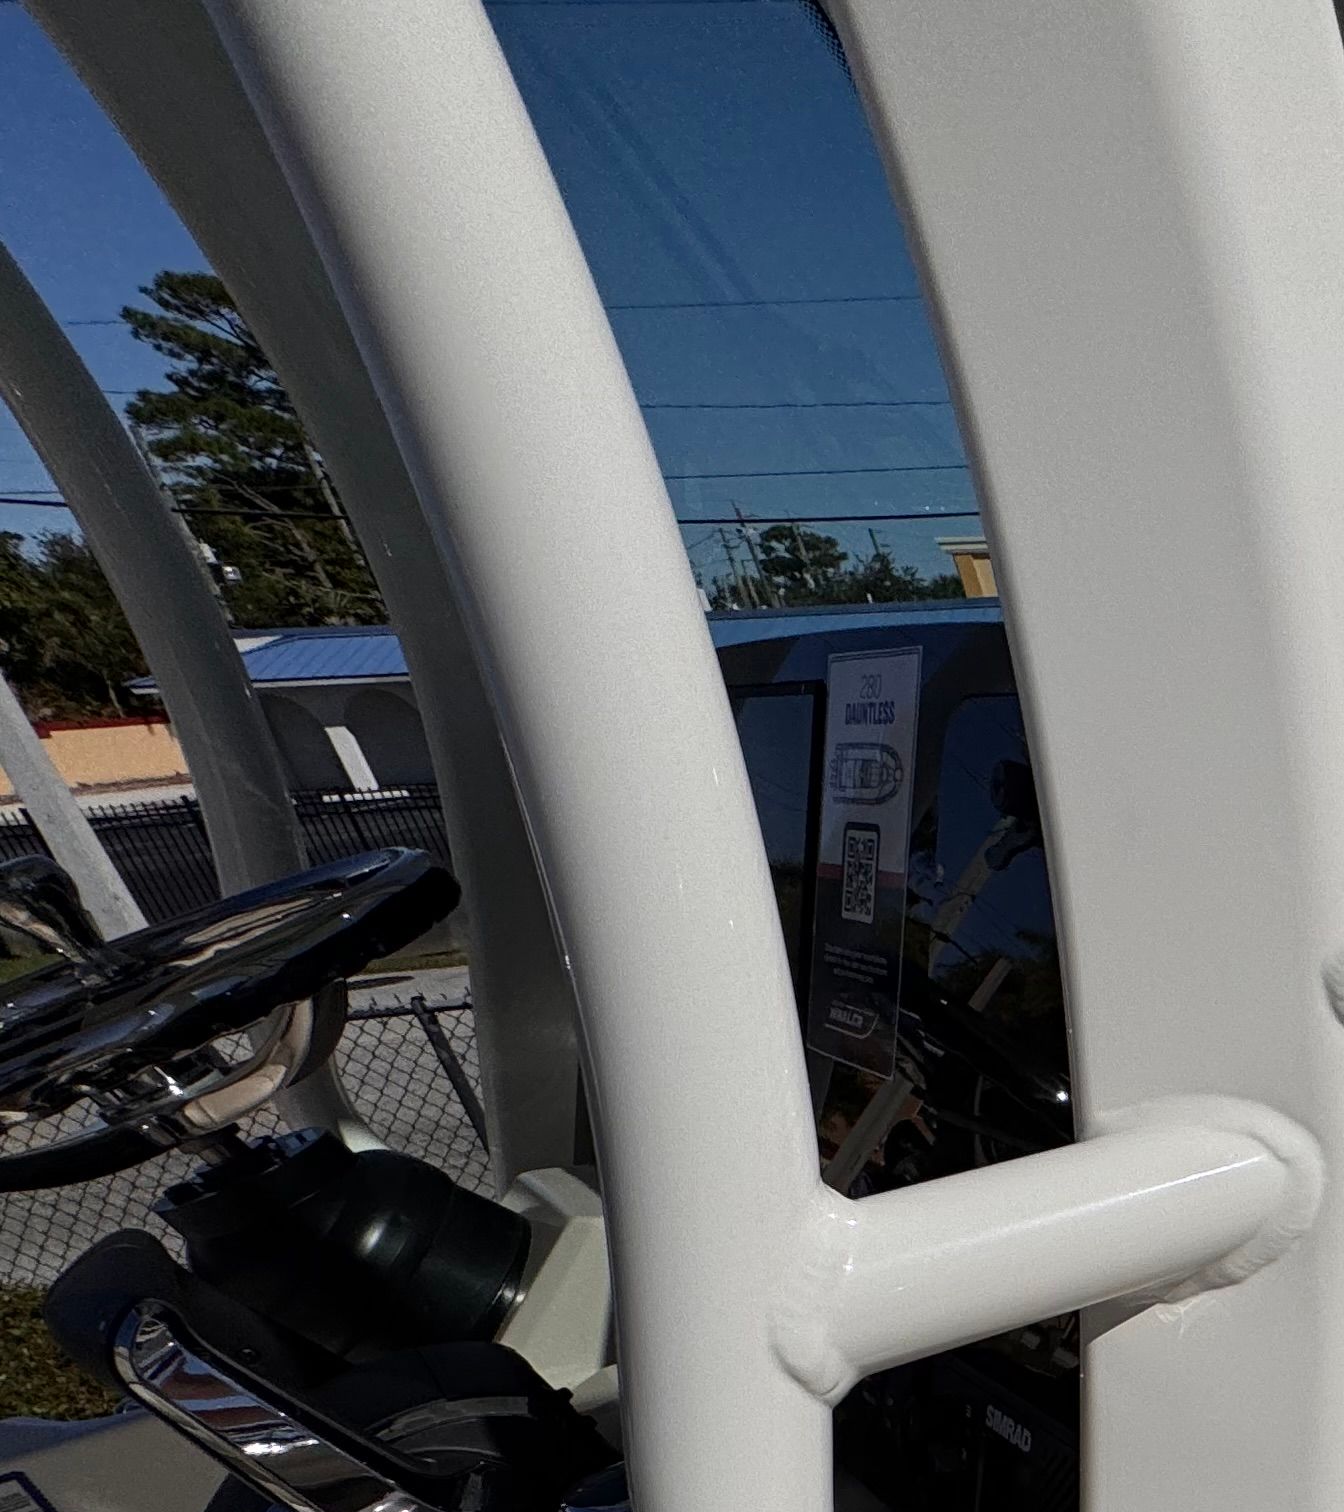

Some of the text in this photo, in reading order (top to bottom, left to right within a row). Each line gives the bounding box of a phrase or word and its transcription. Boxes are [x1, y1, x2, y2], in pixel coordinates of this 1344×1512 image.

[859, 673, 882, 700] 280
[844, 700, 896, 726] DAUNTLESS
[985, 1404, 1032, 1452] SIMRAD
